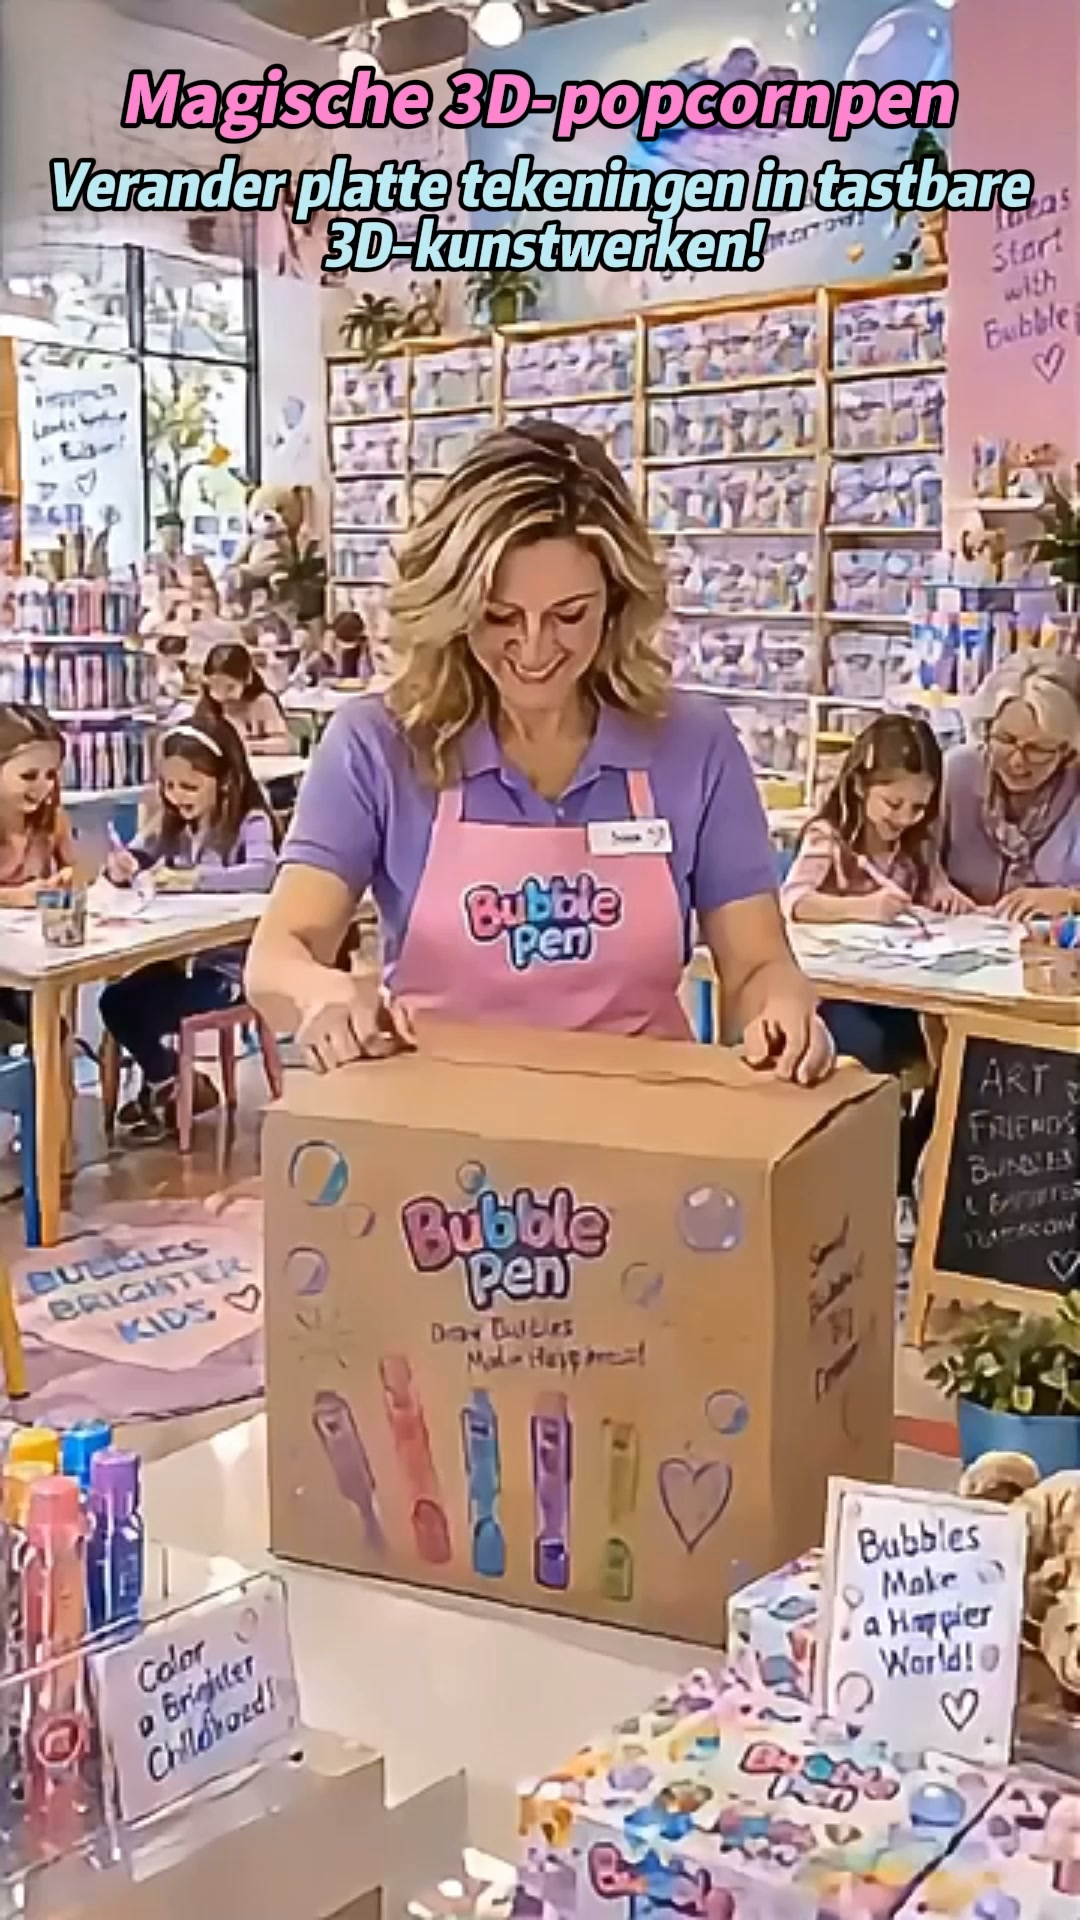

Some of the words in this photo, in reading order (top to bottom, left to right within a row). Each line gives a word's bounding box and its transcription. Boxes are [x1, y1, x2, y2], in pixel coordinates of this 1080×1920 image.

[993, 227, 1062, 273] Start
[1005, 269, 1056, 301] with
[464, 873, 623, 942] Bubble
[981, 1058, 1050, 1098] ART
[969, 1109, 1076, 1143] FRIENDS
[401, 1187, 610, 1272] Bubble
[857, 1517, 980, 1563] Bubbles
[881, 1565, 958, 1600] Make
[863, 1616, 881, 1637] a
[138, 1640, 205, 1693] Color
[879, 1641, 973, 1678] World!
[139, 1715, 154, 1738] a
